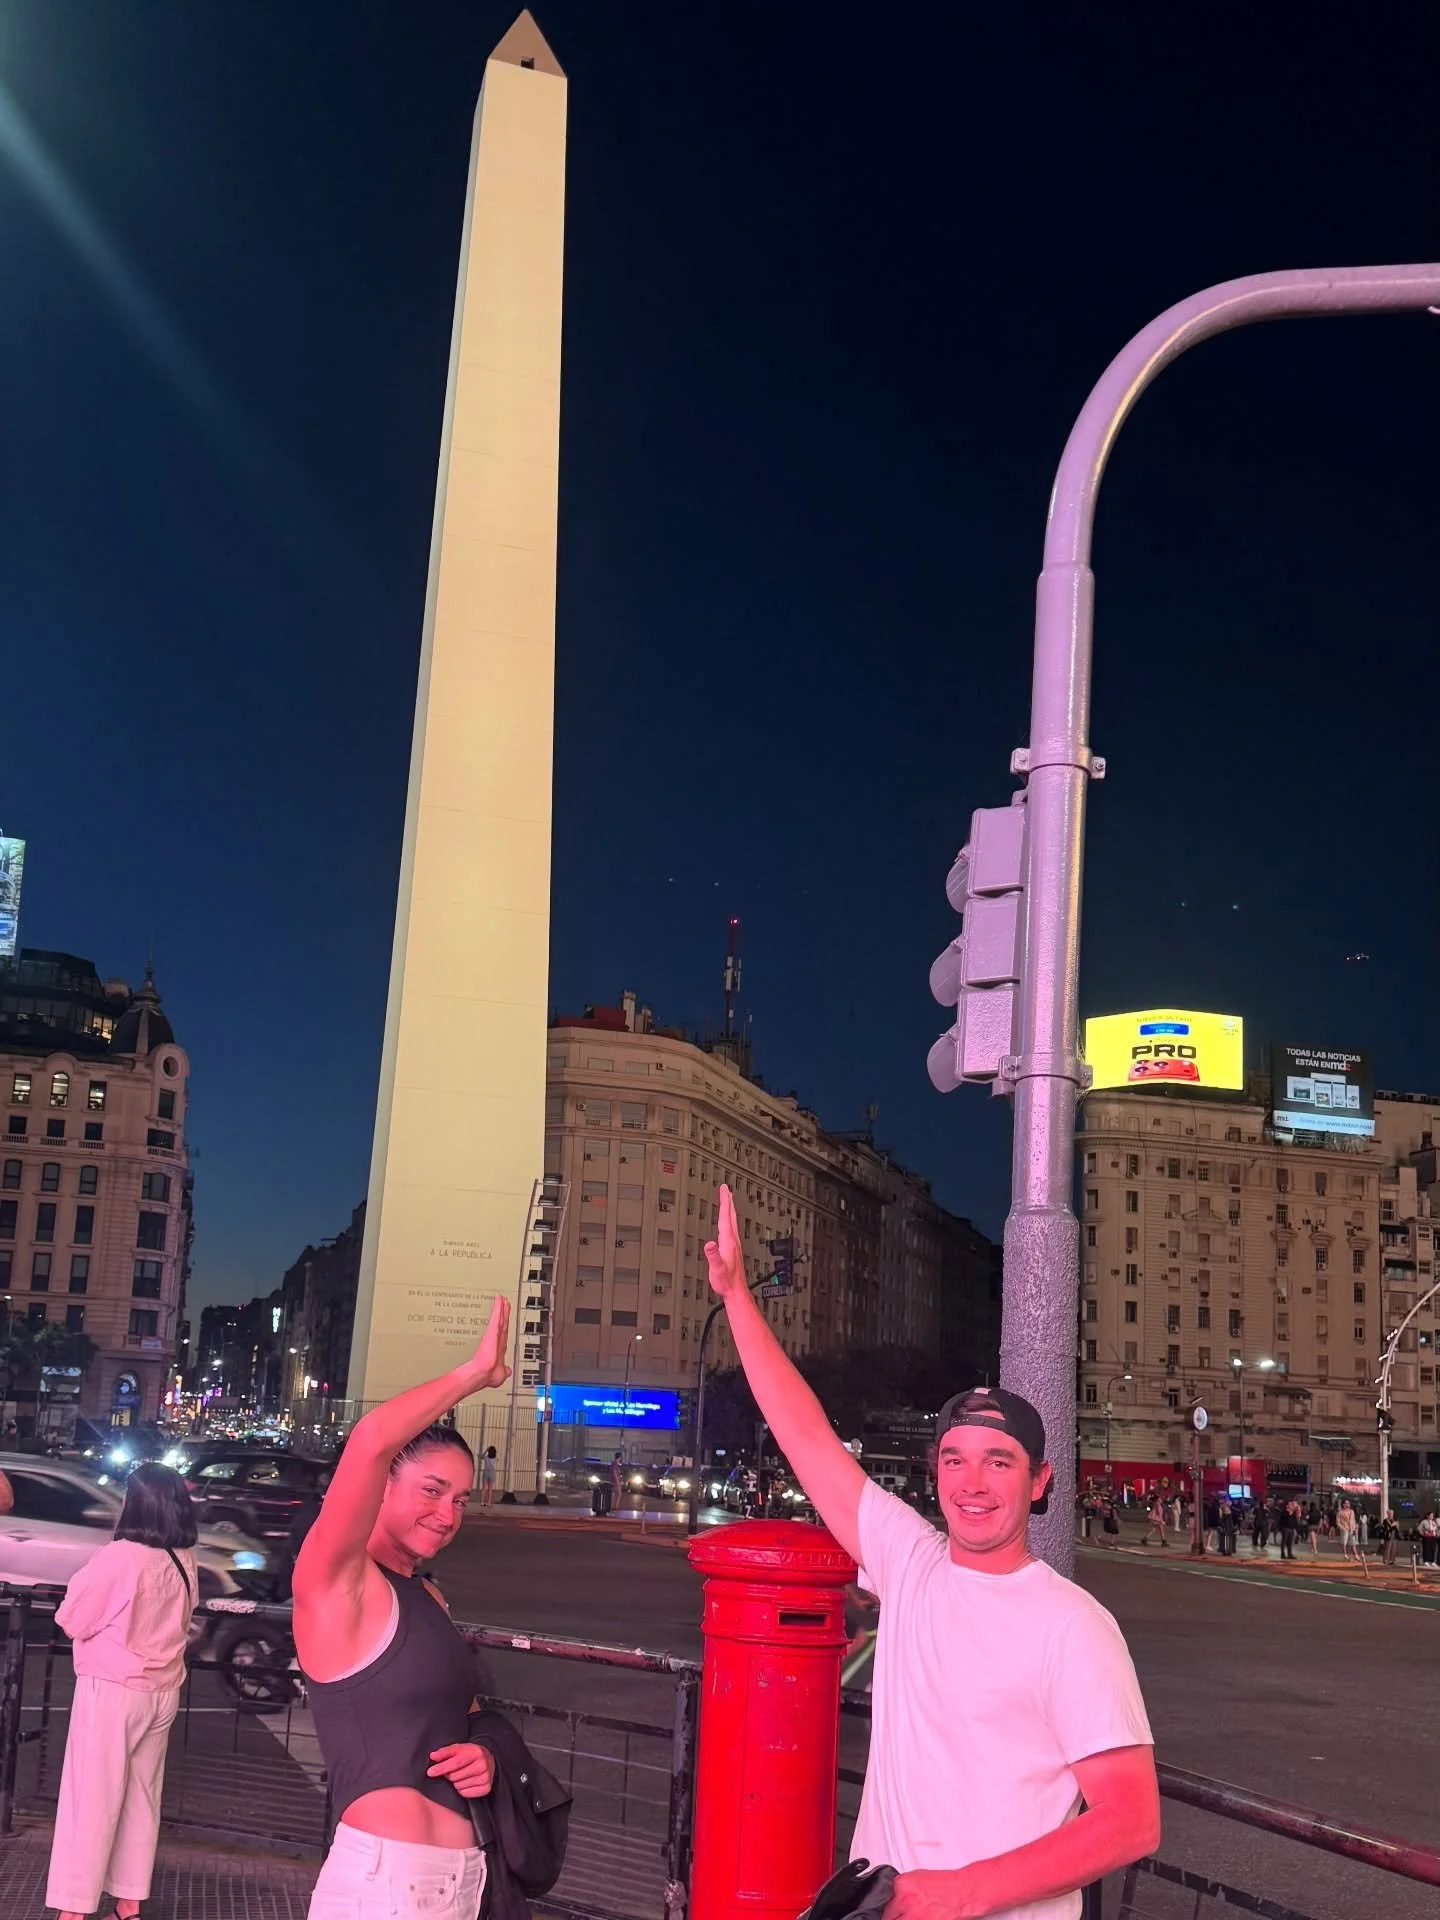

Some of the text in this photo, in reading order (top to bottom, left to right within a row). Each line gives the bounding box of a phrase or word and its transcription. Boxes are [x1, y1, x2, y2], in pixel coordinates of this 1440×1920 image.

[1132, 1044, 1197, 1059] PRO
[1286, 1047, 1361, 1062] TODAS LAS NOTICIAS
[1295, 1058, 1319, 1067] ESTÁN
[439, 1249, 449, 1257] LA
[427, 1314, 454, 1324] PEDRO
